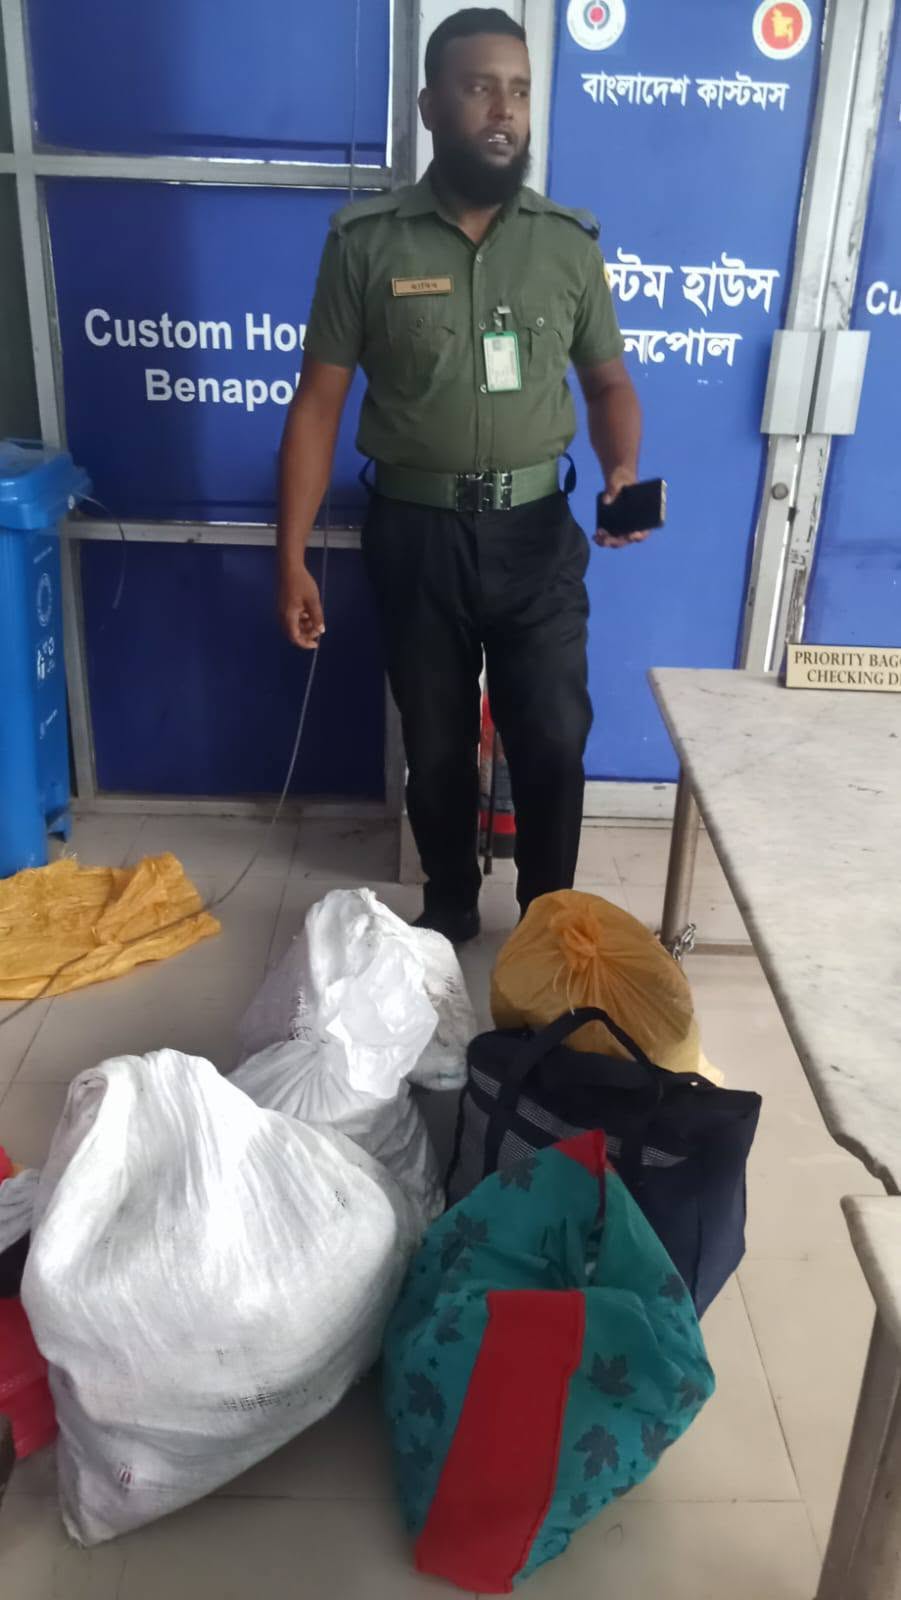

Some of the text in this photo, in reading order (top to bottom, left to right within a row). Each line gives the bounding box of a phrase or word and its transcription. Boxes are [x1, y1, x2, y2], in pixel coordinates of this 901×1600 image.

[581, 71, 790, 112] বাংলাদেশ কাস্টমস
[680, 252, 780, 317] হাউস
[84, 308, 233, 350] Custom
[794, 651, 901, 667] PRIORITY BAG
[807, 670, 883, 685] CHECKING
